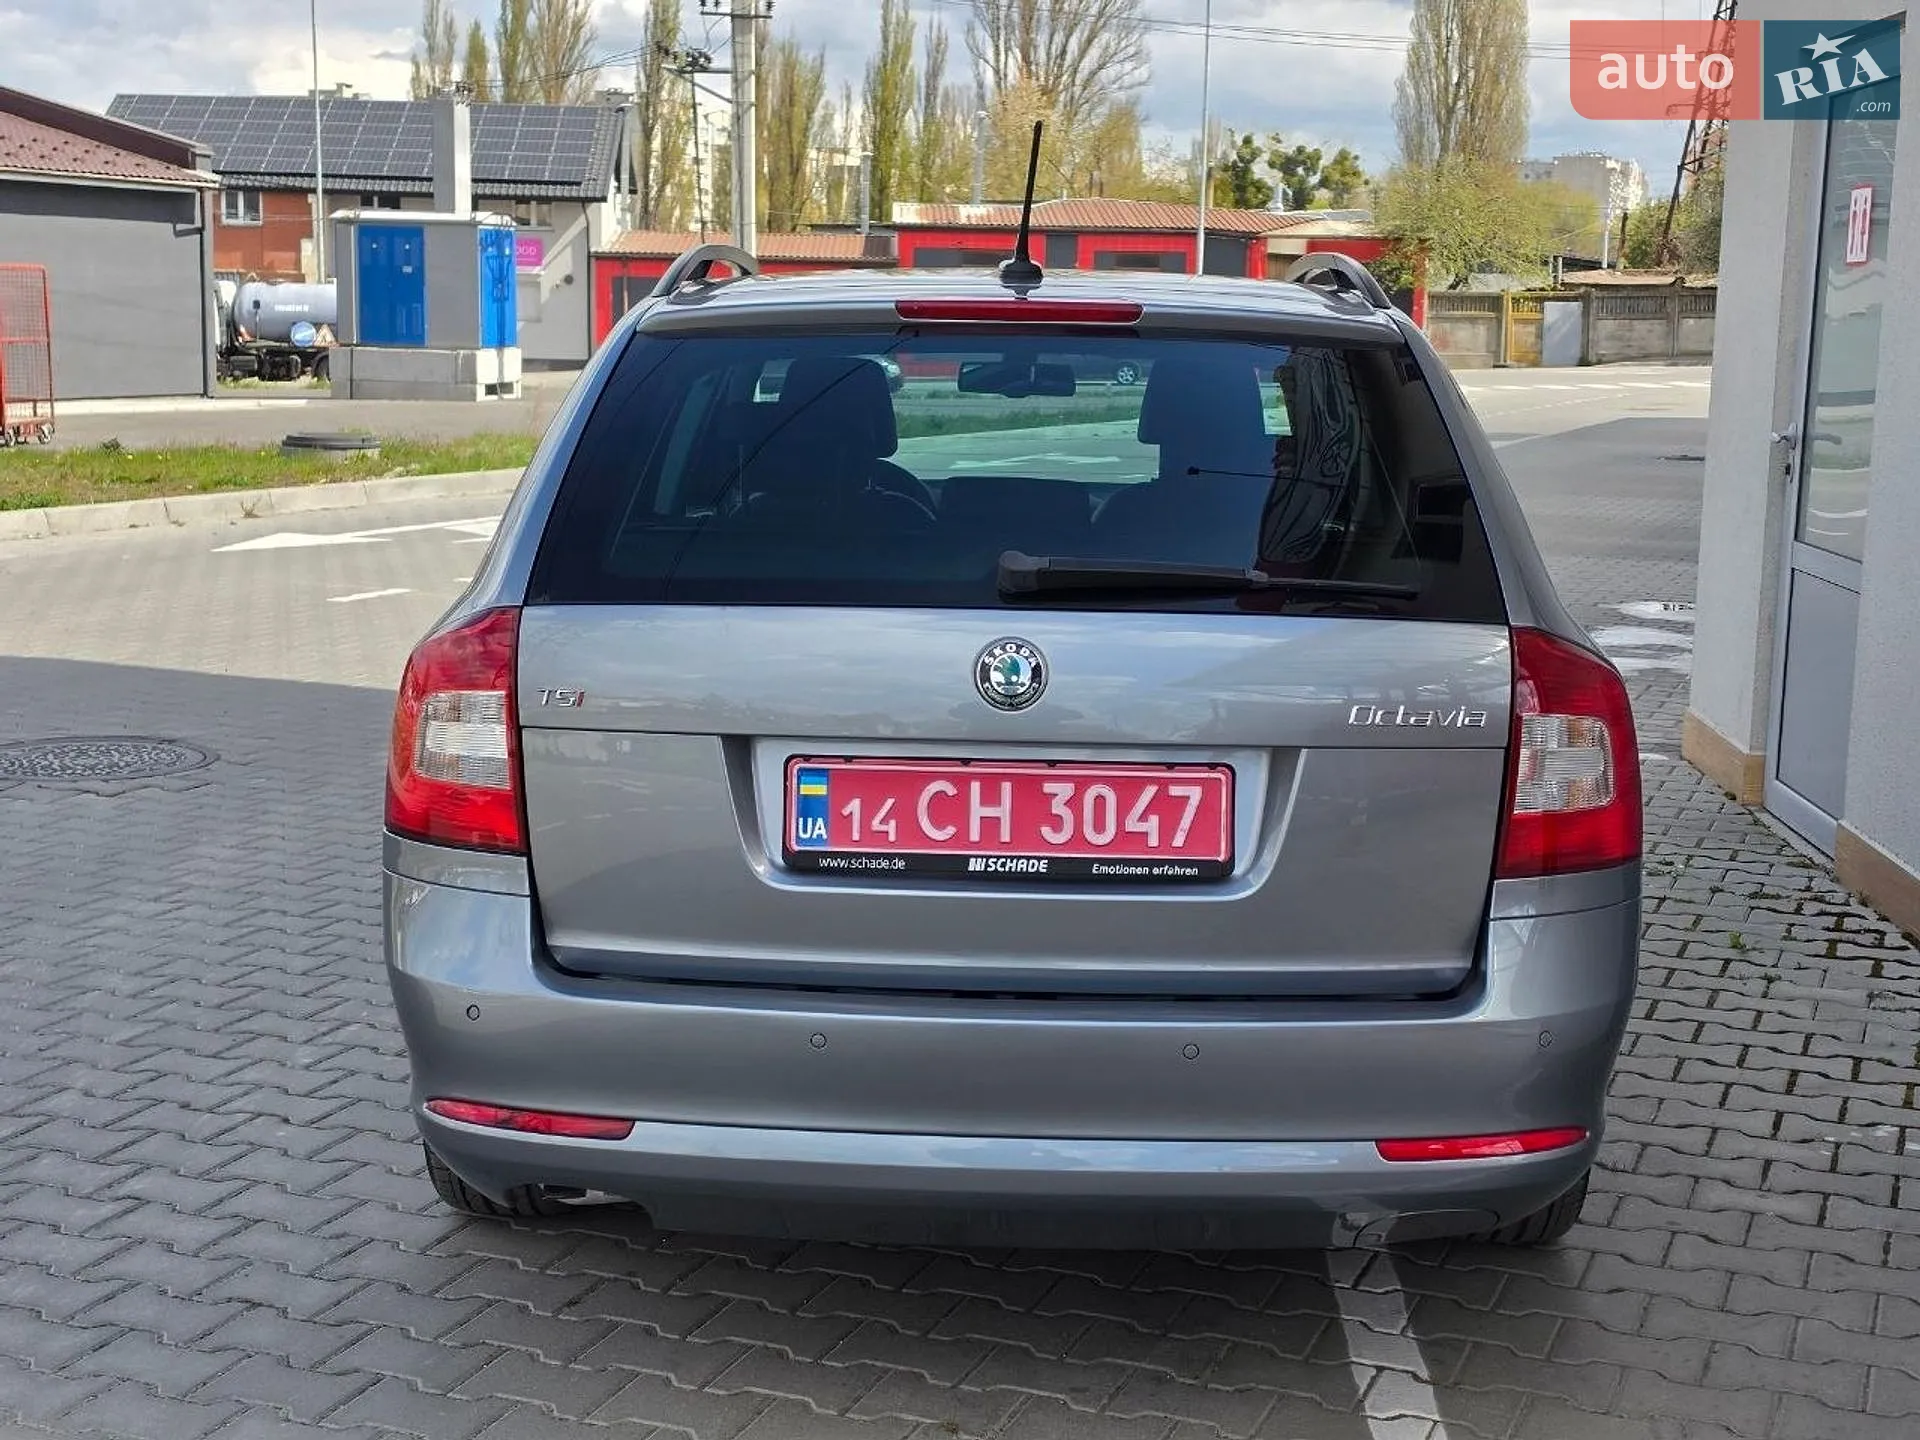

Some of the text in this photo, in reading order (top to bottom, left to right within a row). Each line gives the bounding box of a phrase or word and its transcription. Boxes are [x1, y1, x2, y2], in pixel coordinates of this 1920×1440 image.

[1348, 704, 1487, 728] Octavia
[840, 779, 1203, 848] 14 CH 3047
[798, 817, 828, 840] UA
[818, 856, 906, 870] www.schade.de
[987, 858, 1049, 872] SCHADE
[1091, 863, 1199, 878] Emotionen erfahren
